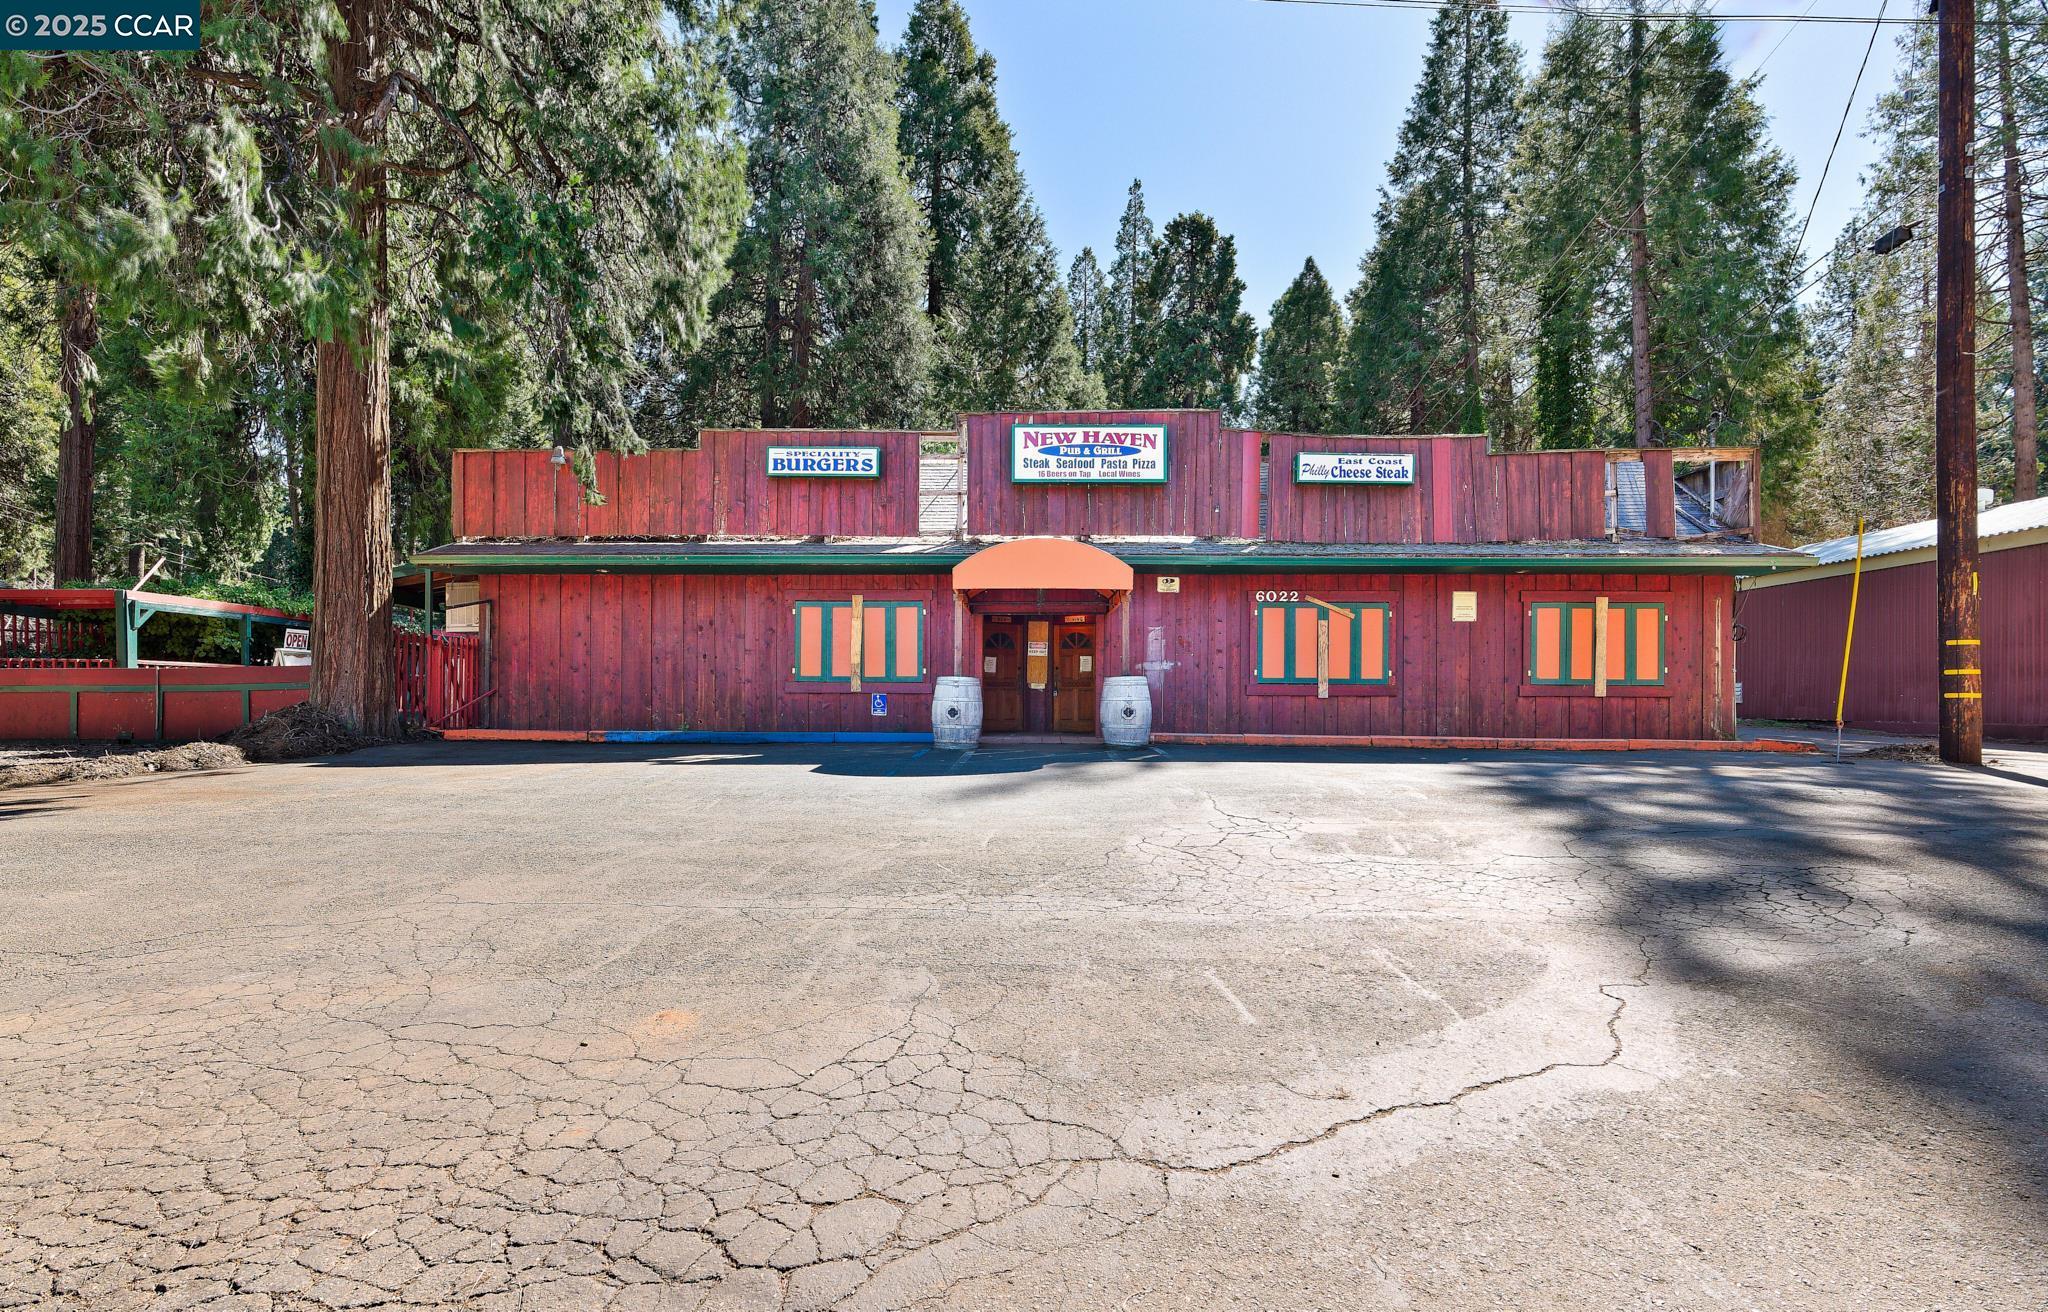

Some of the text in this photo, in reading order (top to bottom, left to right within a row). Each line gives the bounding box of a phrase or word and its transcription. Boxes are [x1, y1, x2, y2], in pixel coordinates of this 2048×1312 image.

[1023, 430, 1158, 450] NEW HAVEN
[1059, 446, 1122, 456] PUB & GRILL
[772, 458, 873, 472] BURGERS
[1023, 458, 1156, 469] Steak Seafood Pasta Pizza
[1338, 457, 1402, 465] East Coast
[1079, 471, 1091, 479] Tap
[1301, 463, 1409, 479] Philly Cheese Steak
[1255, 590, 1299, 602] 6022
[286, 634, 307, 647] OPEN
